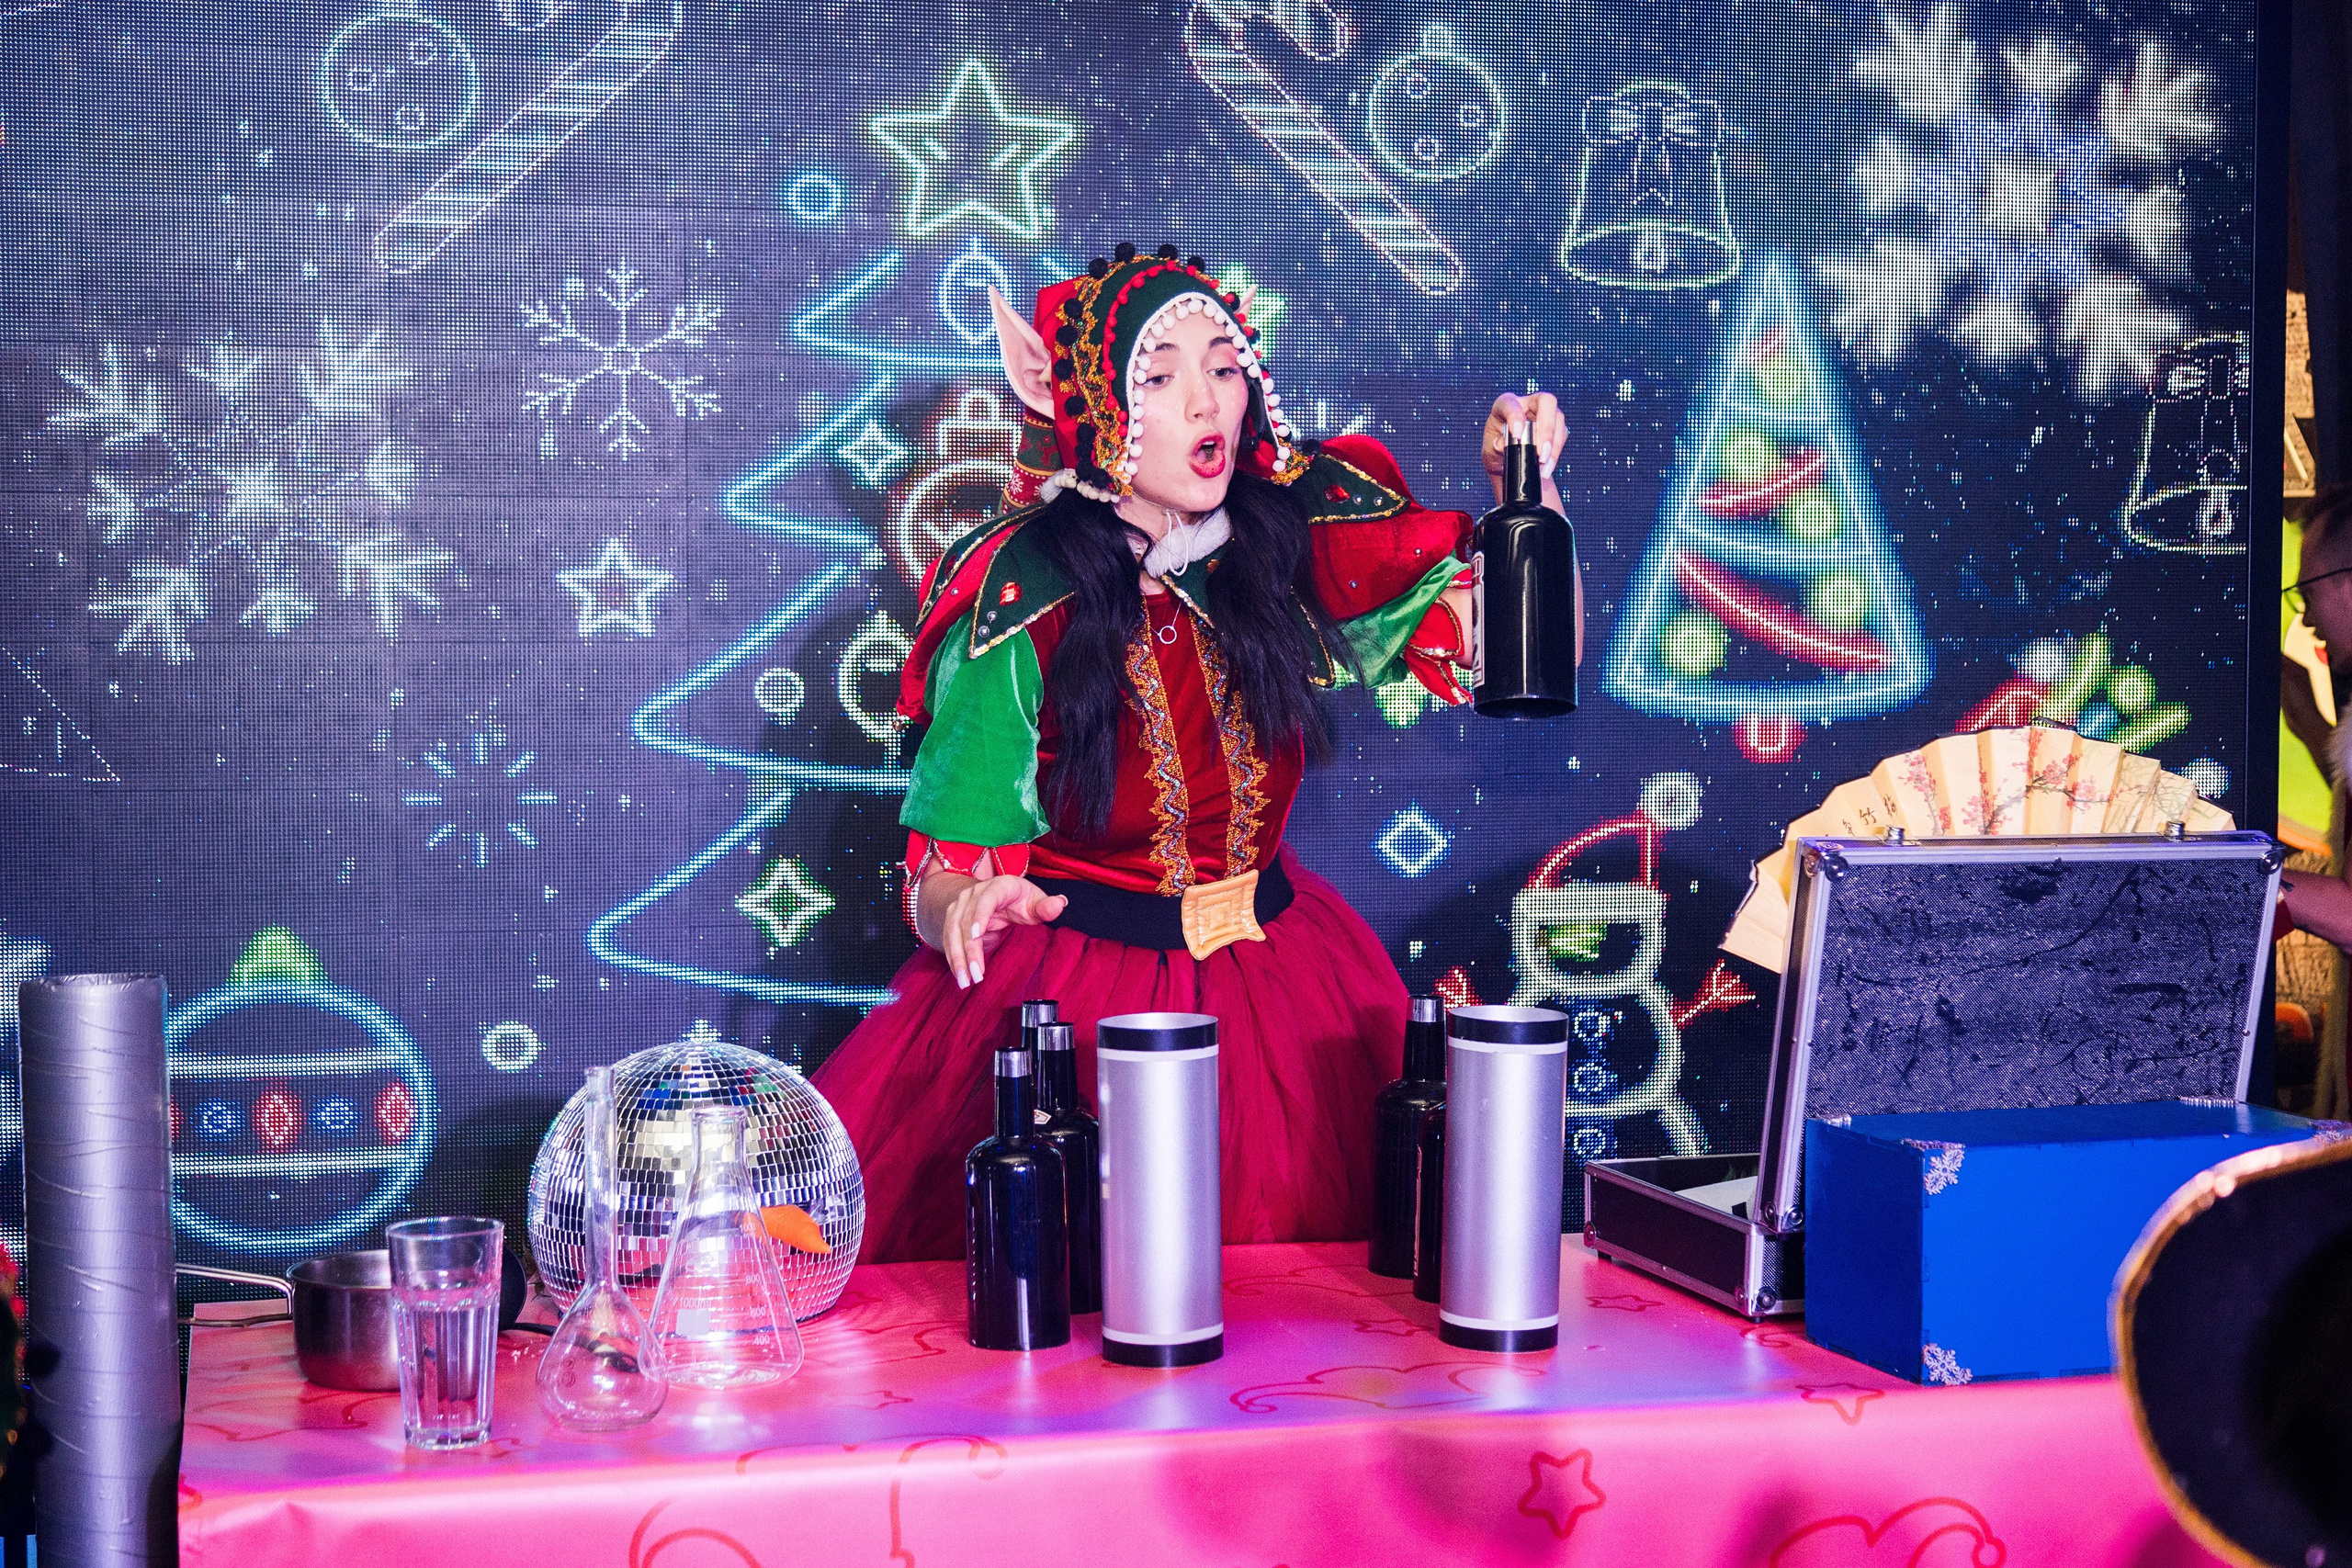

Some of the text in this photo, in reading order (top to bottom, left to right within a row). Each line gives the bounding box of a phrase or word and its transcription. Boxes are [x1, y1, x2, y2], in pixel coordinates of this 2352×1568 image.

[745, 1274, 762, 1284] 800
[750, 1306, 766, 1318] 600
[754, 1335, 771, 1345] 400
